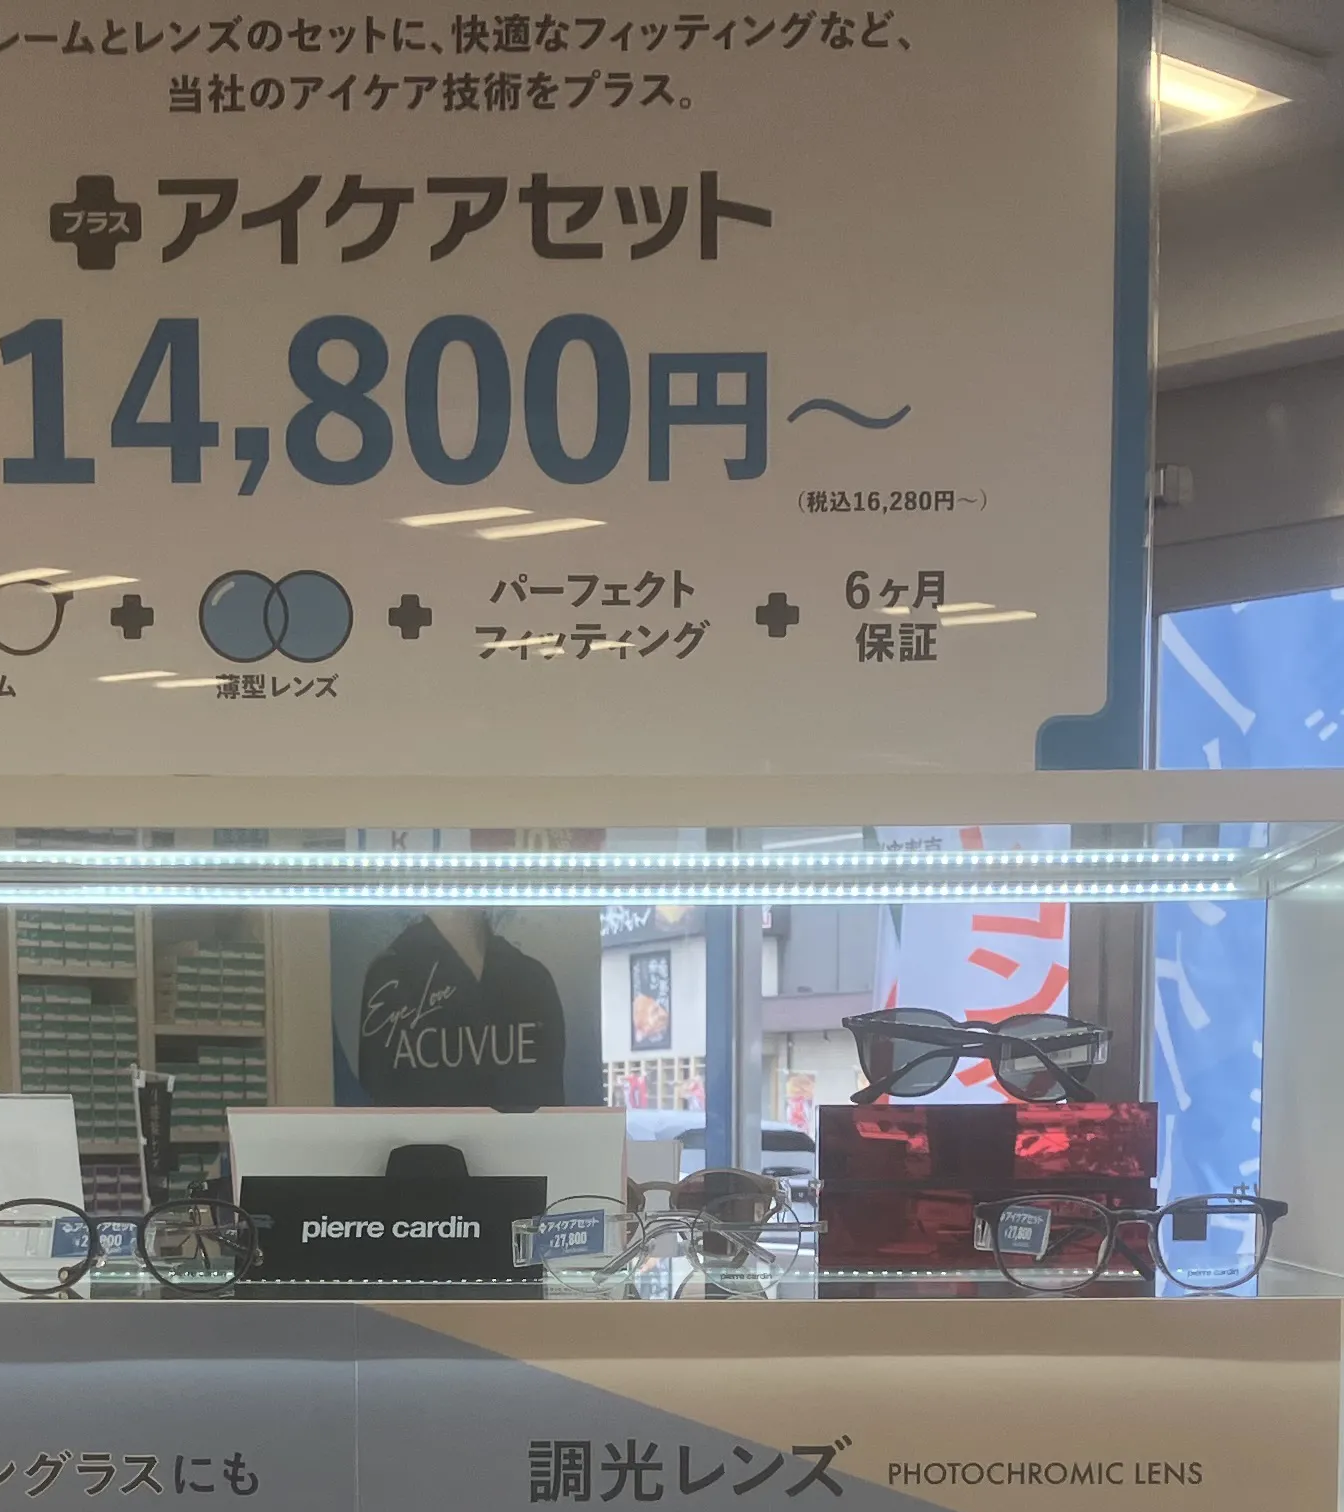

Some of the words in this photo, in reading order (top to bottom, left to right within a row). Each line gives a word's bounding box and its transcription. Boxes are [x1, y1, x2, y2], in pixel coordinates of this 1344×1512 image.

[167, 72, 694, 114] 当社のアイケア技術をプラス。
[158, 171, 773, 265] アイケアセット
[489, 568, 695, 609] パーフェクト
[476, 617, 710, 661] フィッティング
[855, 622, 938, 662] 保証
[214, 672, 338, 699] 薄型レンズ
[392, 1021, 539, 1070] ACUVUE
[300, 1214, 385, 1244] pierre
[391, 1214, 481, 1240] cardin
[526, 1434, 855, 1505] 調光レンズ
[887, 1460, 1125, 1488] PHOTOCHROMIC
[1135, 1460, 1204, 1487] LENS
